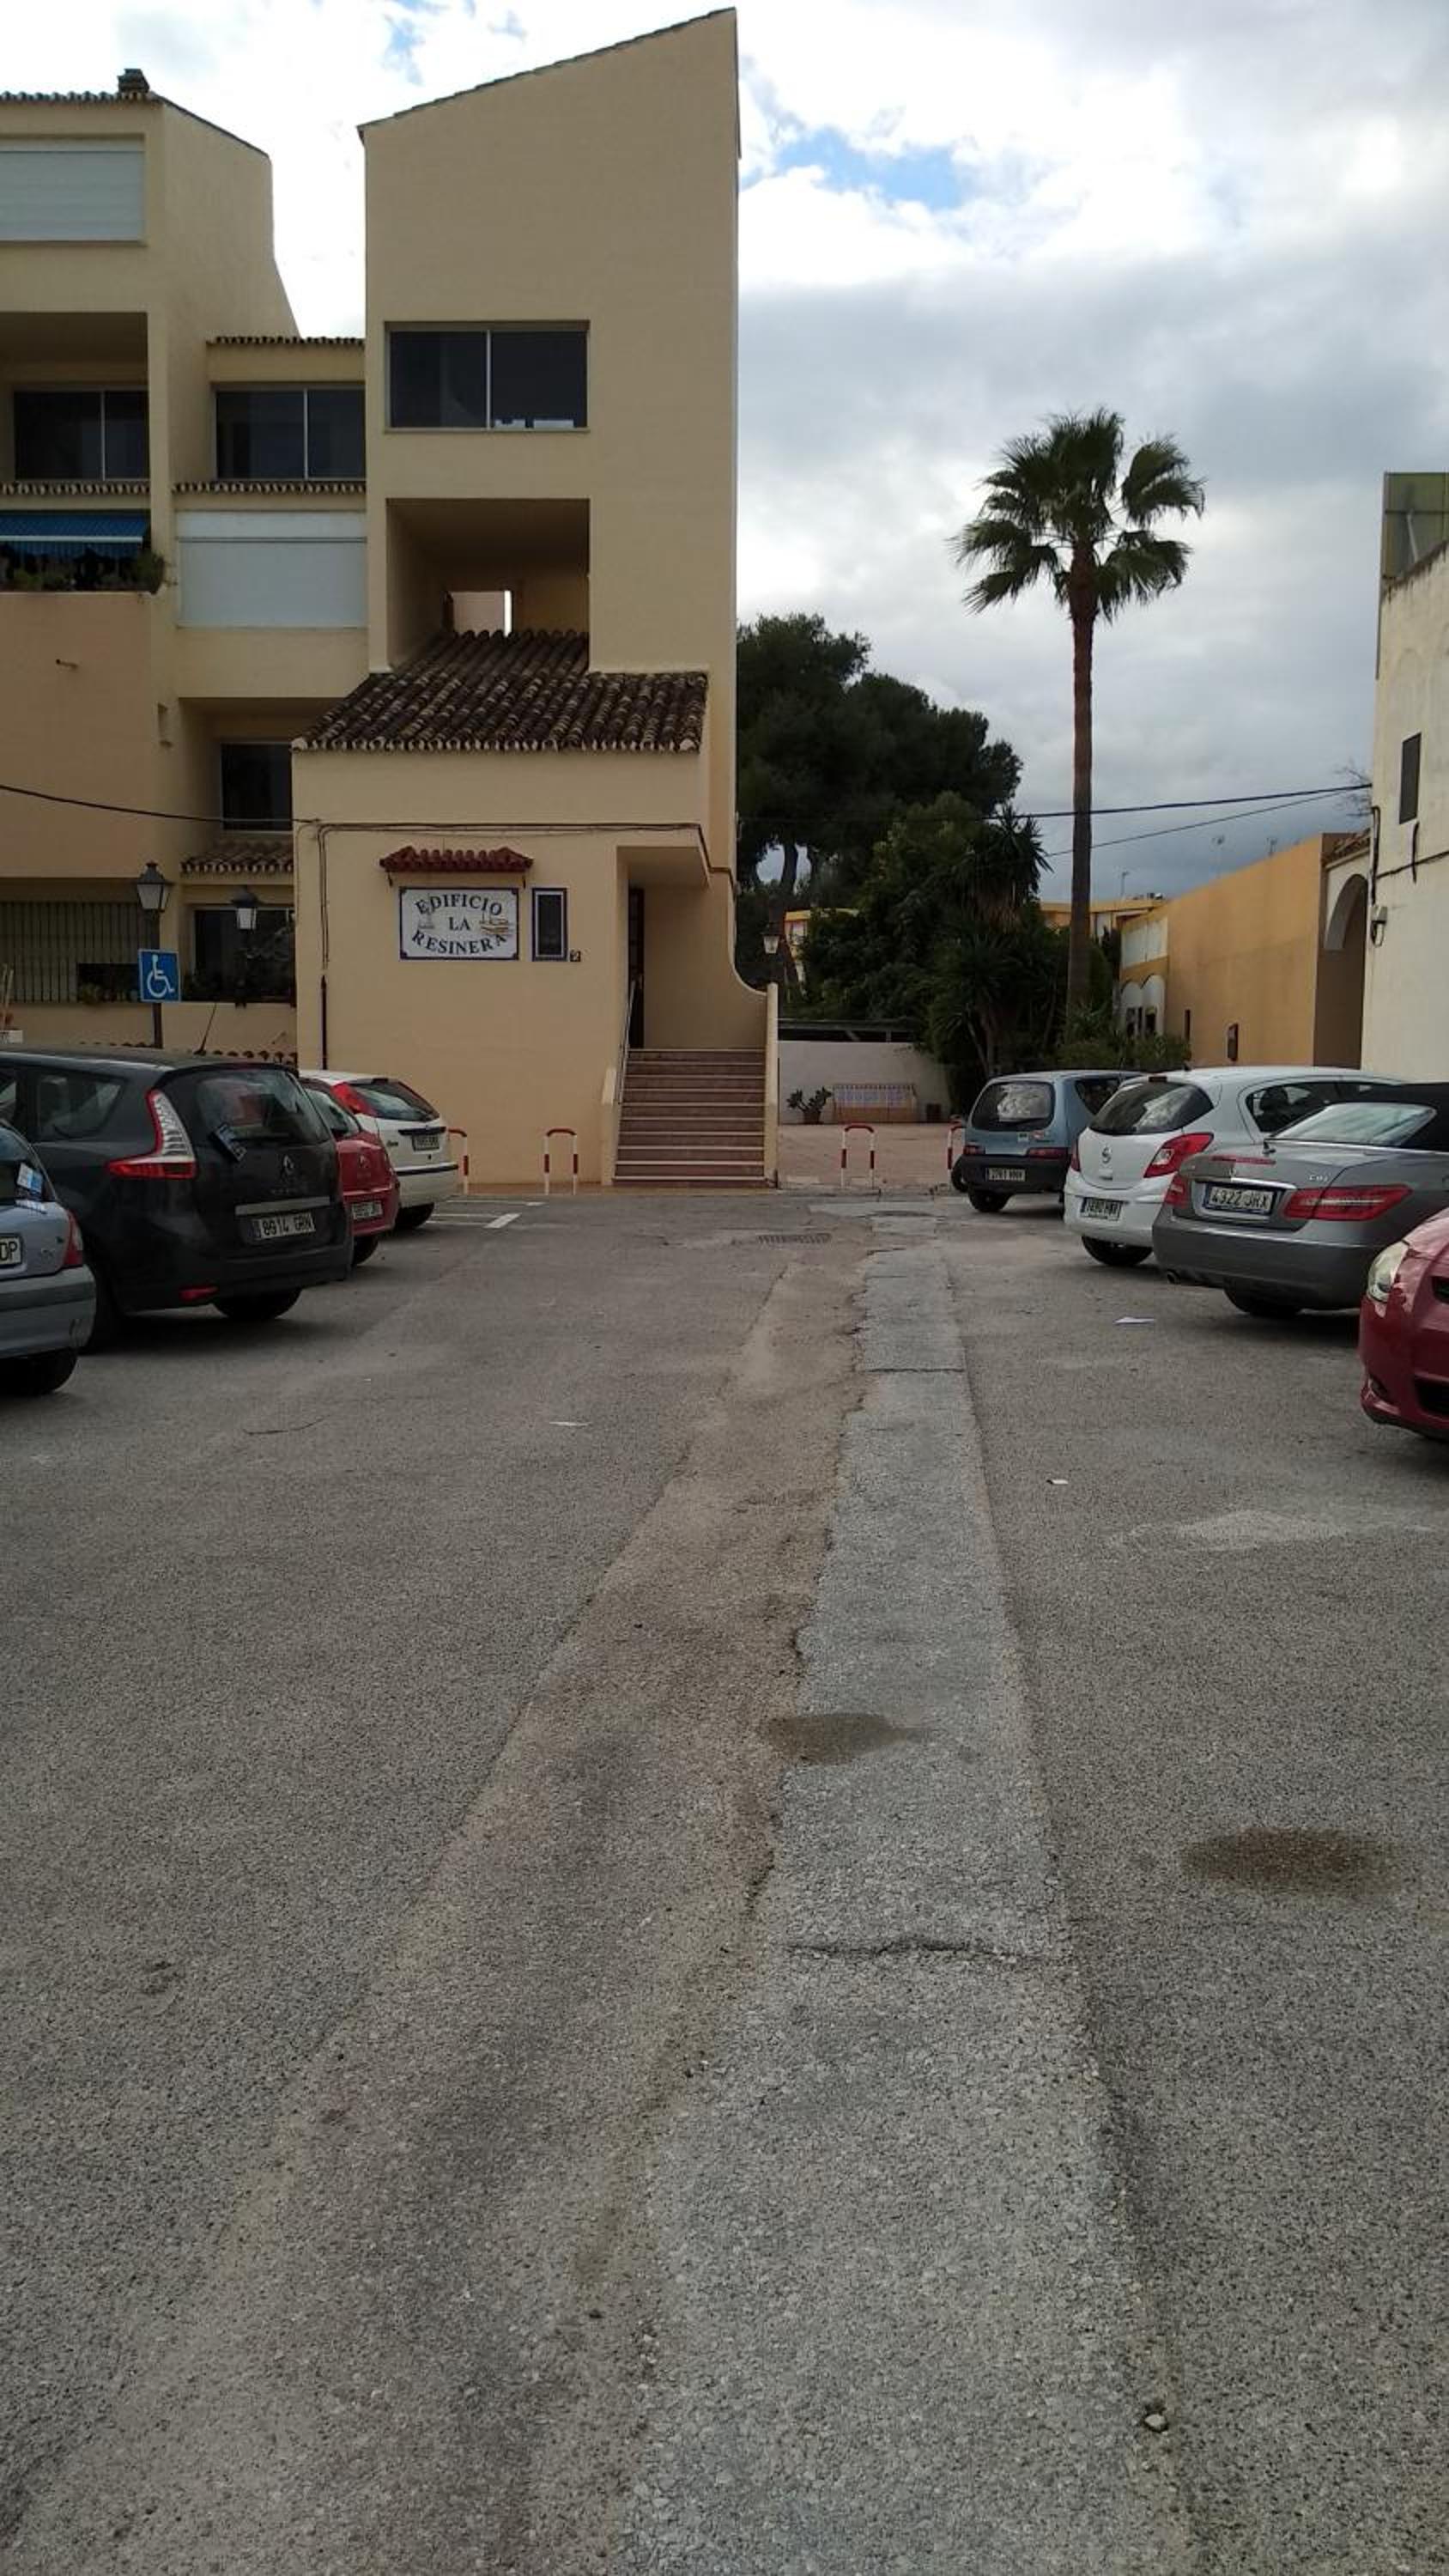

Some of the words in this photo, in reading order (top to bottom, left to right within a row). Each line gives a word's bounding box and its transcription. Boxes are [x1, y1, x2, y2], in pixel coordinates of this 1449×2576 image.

[415, 893, 502, 915] EDIFICIO
[449, 916, 470, 931] LA
[412, 929, 507, 954] RESINERA
